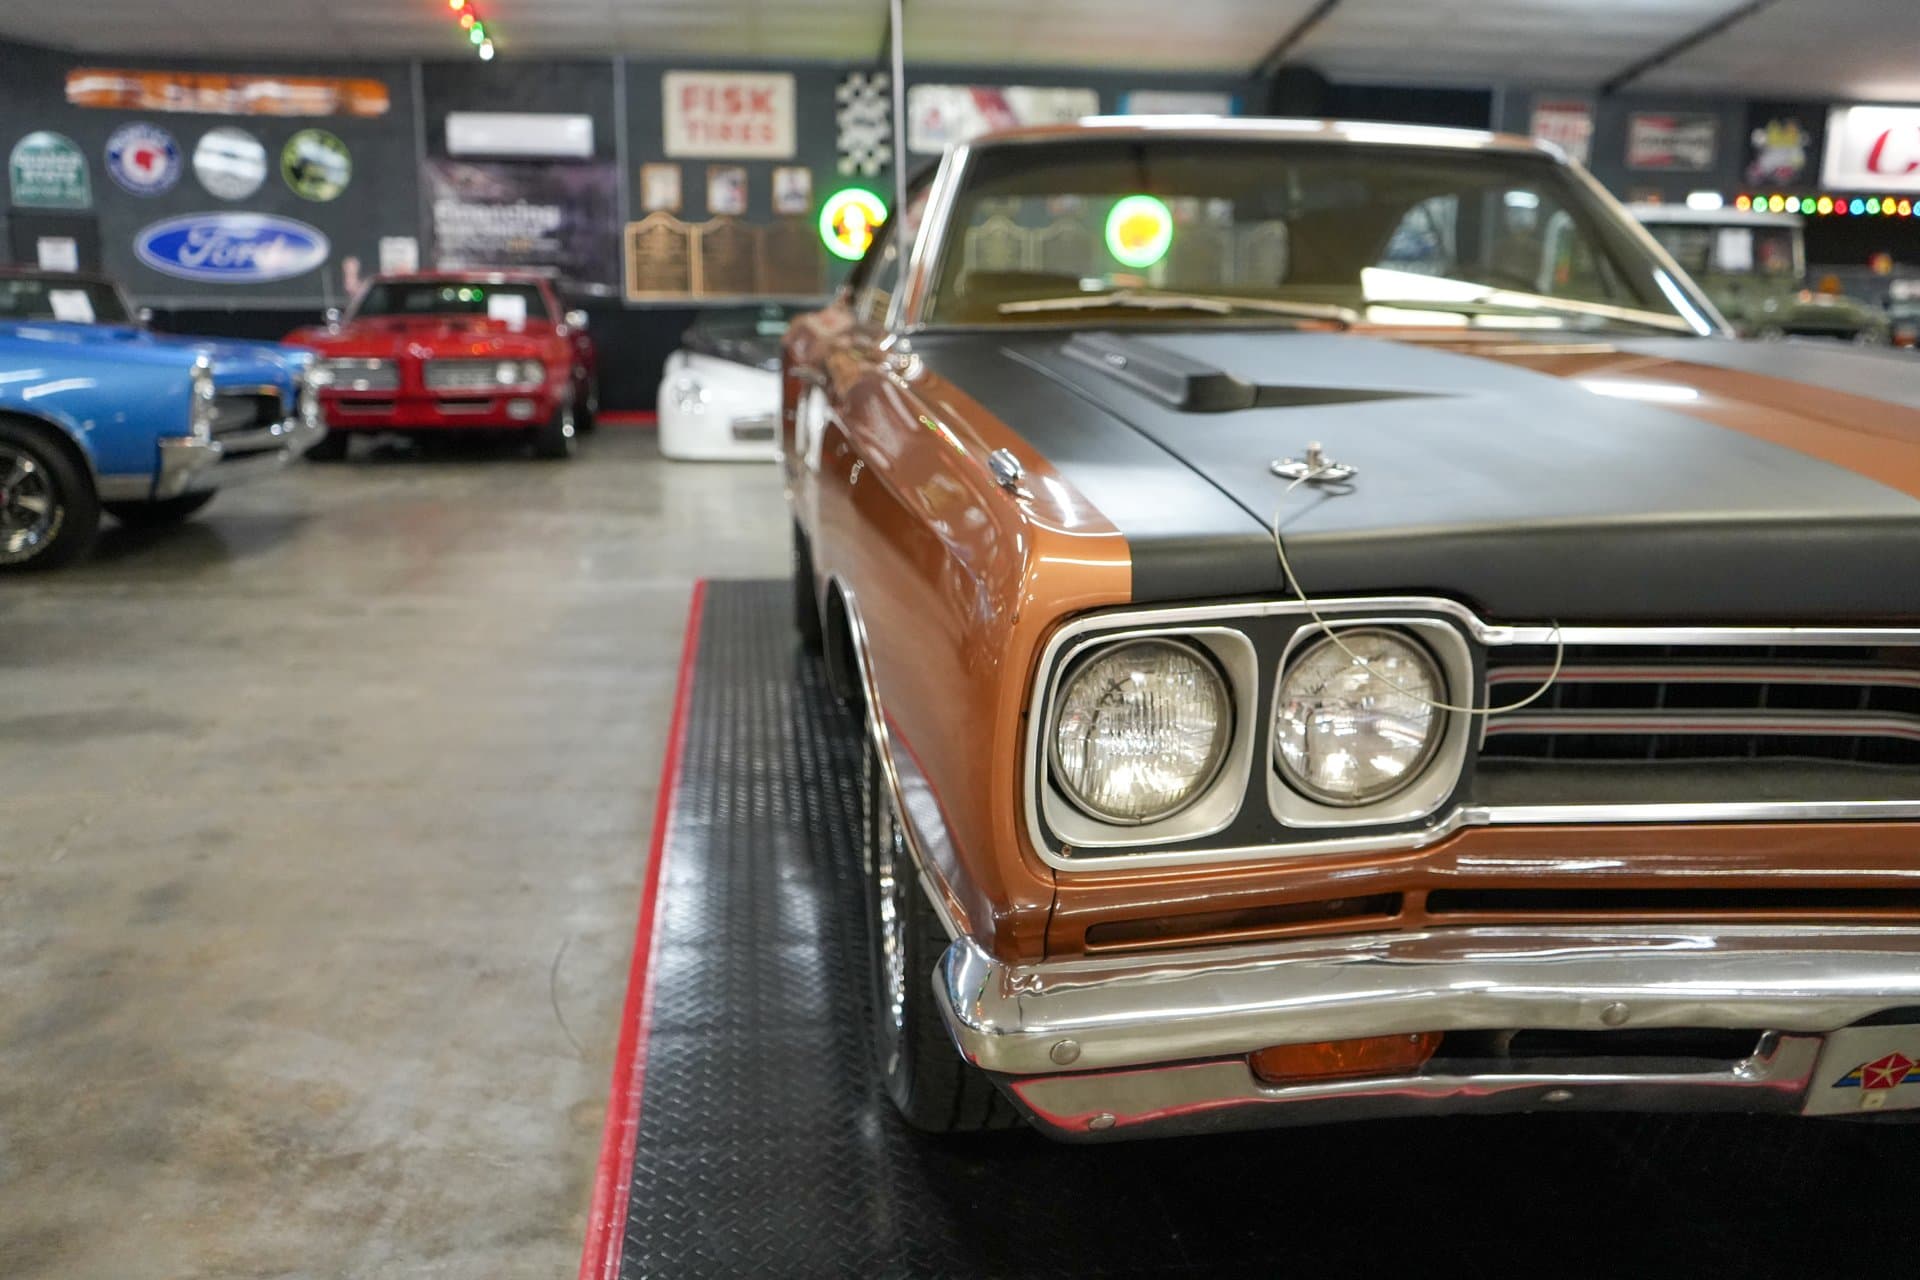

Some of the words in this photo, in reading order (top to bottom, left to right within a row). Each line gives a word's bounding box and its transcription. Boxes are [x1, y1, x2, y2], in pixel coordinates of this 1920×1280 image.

[680, 85, 775, 114] FISK
[686, 119, 775, 142] TIRES
[178, 223, 292, 268] Ford
